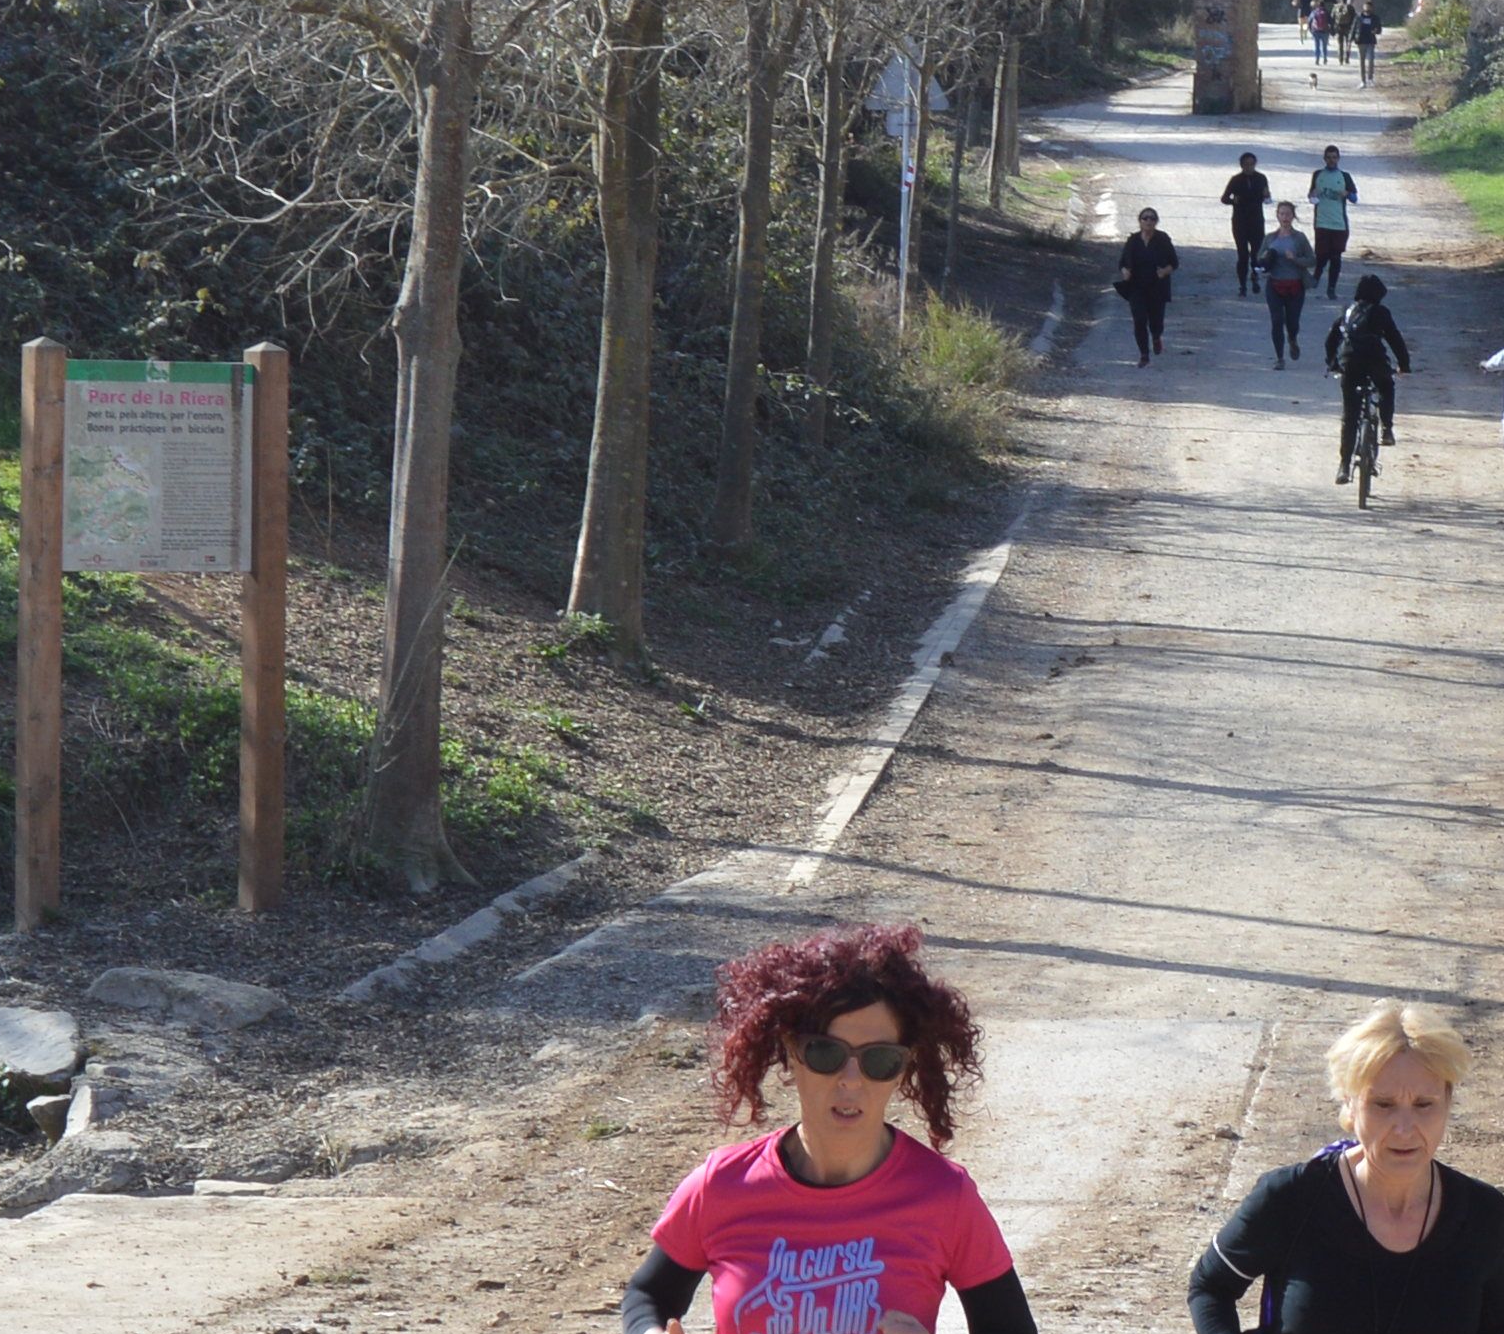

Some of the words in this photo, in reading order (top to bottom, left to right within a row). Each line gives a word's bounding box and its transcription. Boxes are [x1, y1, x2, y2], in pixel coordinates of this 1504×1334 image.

[87, 389, 126, 405] Parc
[132, 390, 153, 405] de
[159, 390, 175, 405] la
[180, 391, 225, 406] Riera
